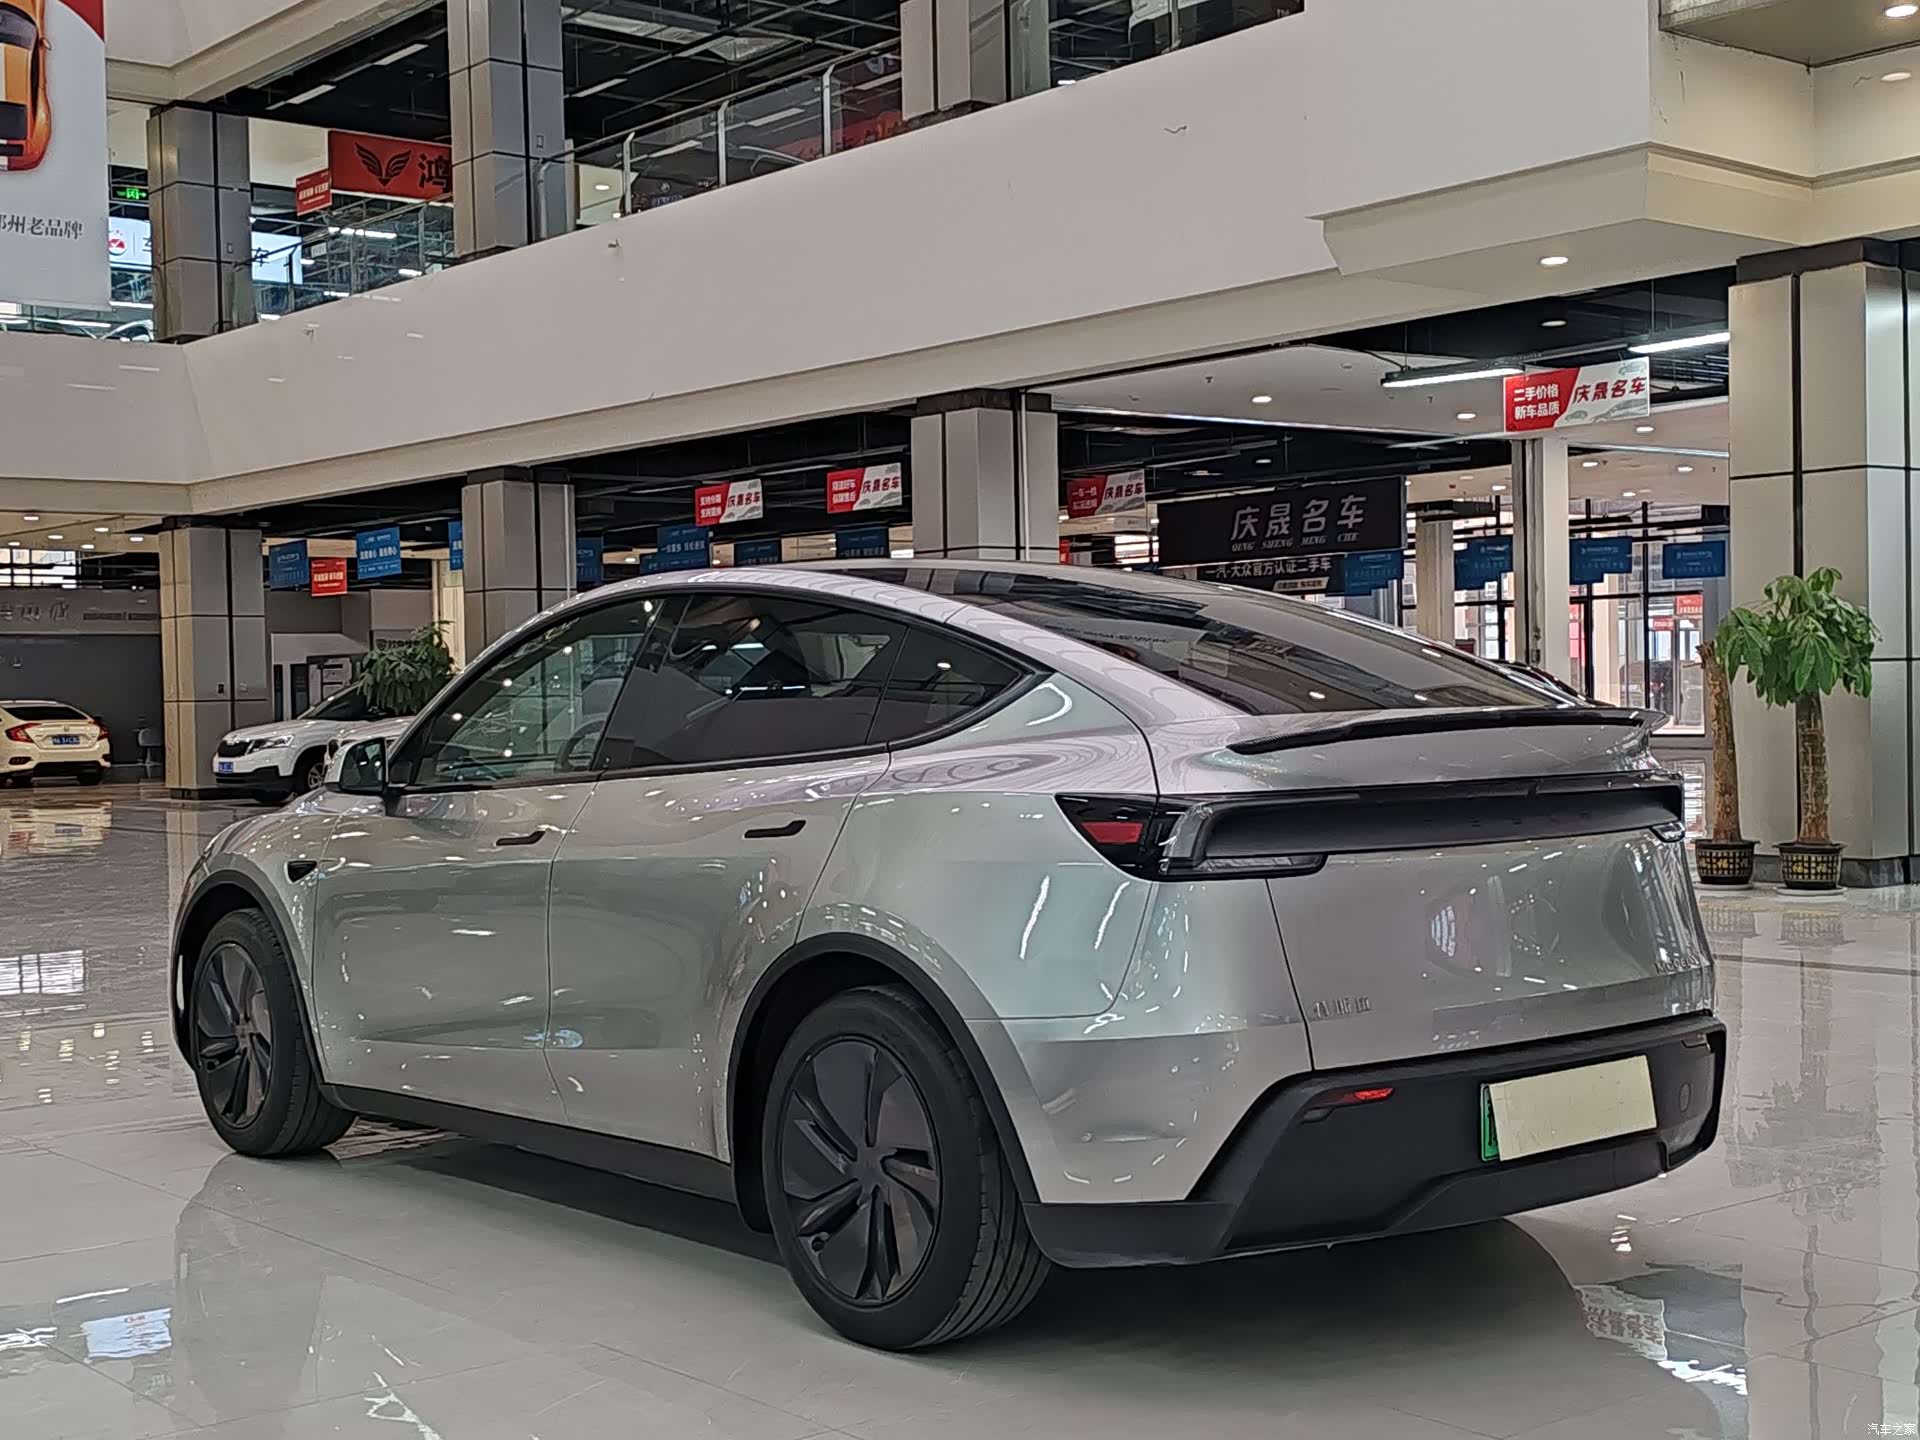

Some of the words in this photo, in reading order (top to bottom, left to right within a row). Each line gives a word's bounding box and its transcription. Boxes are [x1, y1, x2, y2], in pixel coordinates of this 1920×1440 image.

[1513, 383, 1560, 402] 二手价格
[1574, 376, 1648, 404] 庆晟名车
[1514, 401, 1561, 420] 新车品质
[1230, 494, 1367, 541] 庆晟名车
